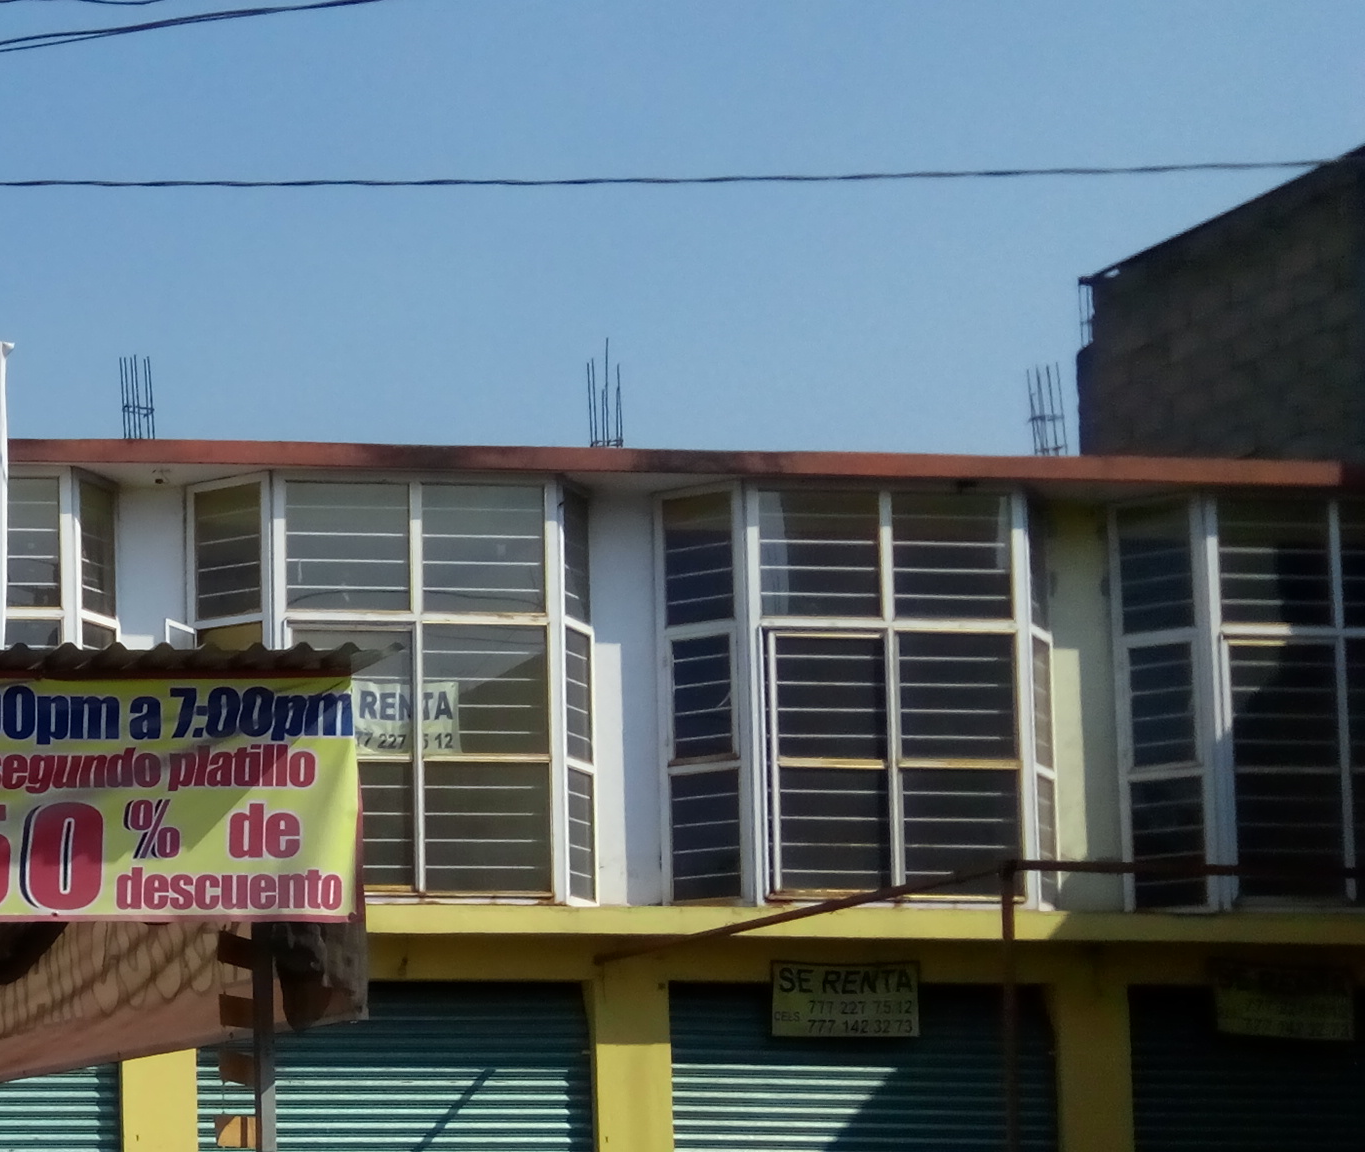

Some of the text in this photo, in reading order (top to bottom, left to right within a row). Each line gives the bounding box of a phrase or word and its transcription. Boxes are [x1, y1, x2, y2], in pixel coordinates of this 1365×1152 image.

[129, 696, 162, 740] a
[170, 686, 355, 741] 7:00pm
[359, 690, 453, 721] RENTA
[377, 732, 407, 749] 227
[435, 732, 453, 749] 12
[168, 744, 316, 791] platillo
[228, 802, 301, 860] de
[116, 867, 343, 911] descuento
[779, 967, 912, 994] SE RENTA
[809, 1000, 834, 1014] 777
[840, 1001, 867, 1014] 227
[807, 1019, 913, 1034] 777 142 32 73
